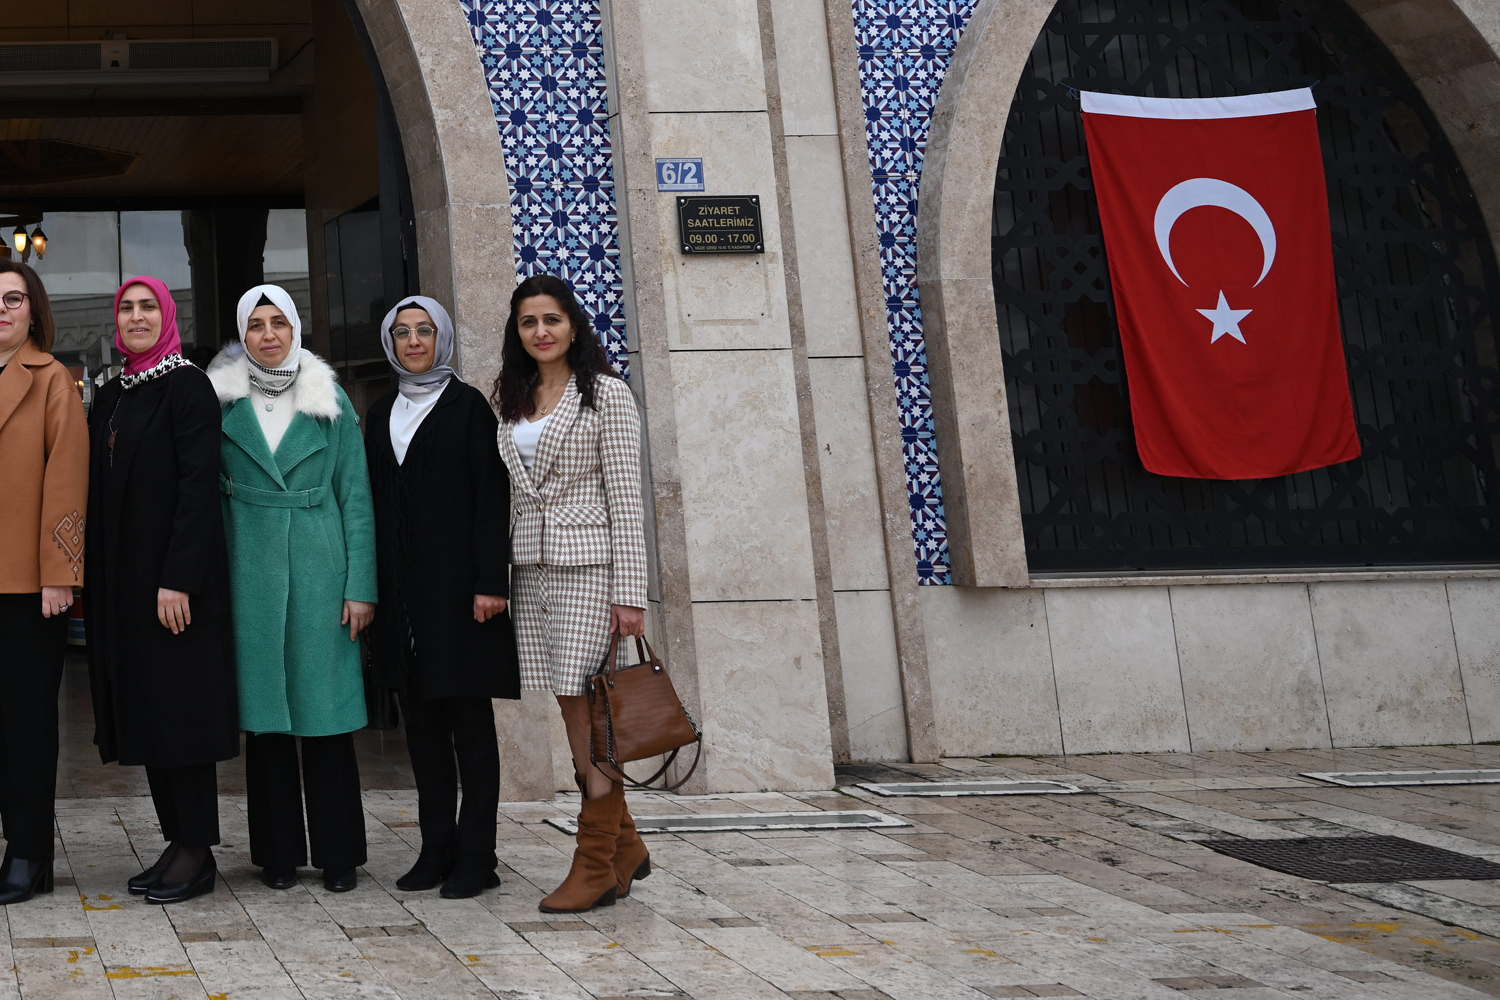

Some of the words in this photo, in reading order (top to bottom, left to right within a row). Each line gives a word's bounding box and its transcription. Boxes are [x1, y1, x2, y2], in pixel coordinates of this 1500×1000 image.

[662, 162, 698, 184] 6/2
[698, 205, 740, 216] ZİYARET
[687, 216, 754, 228] SAATLERİMİZ
[689, 234, 718, 244] 09.00
[727, 233, 755, 243] 17.00
